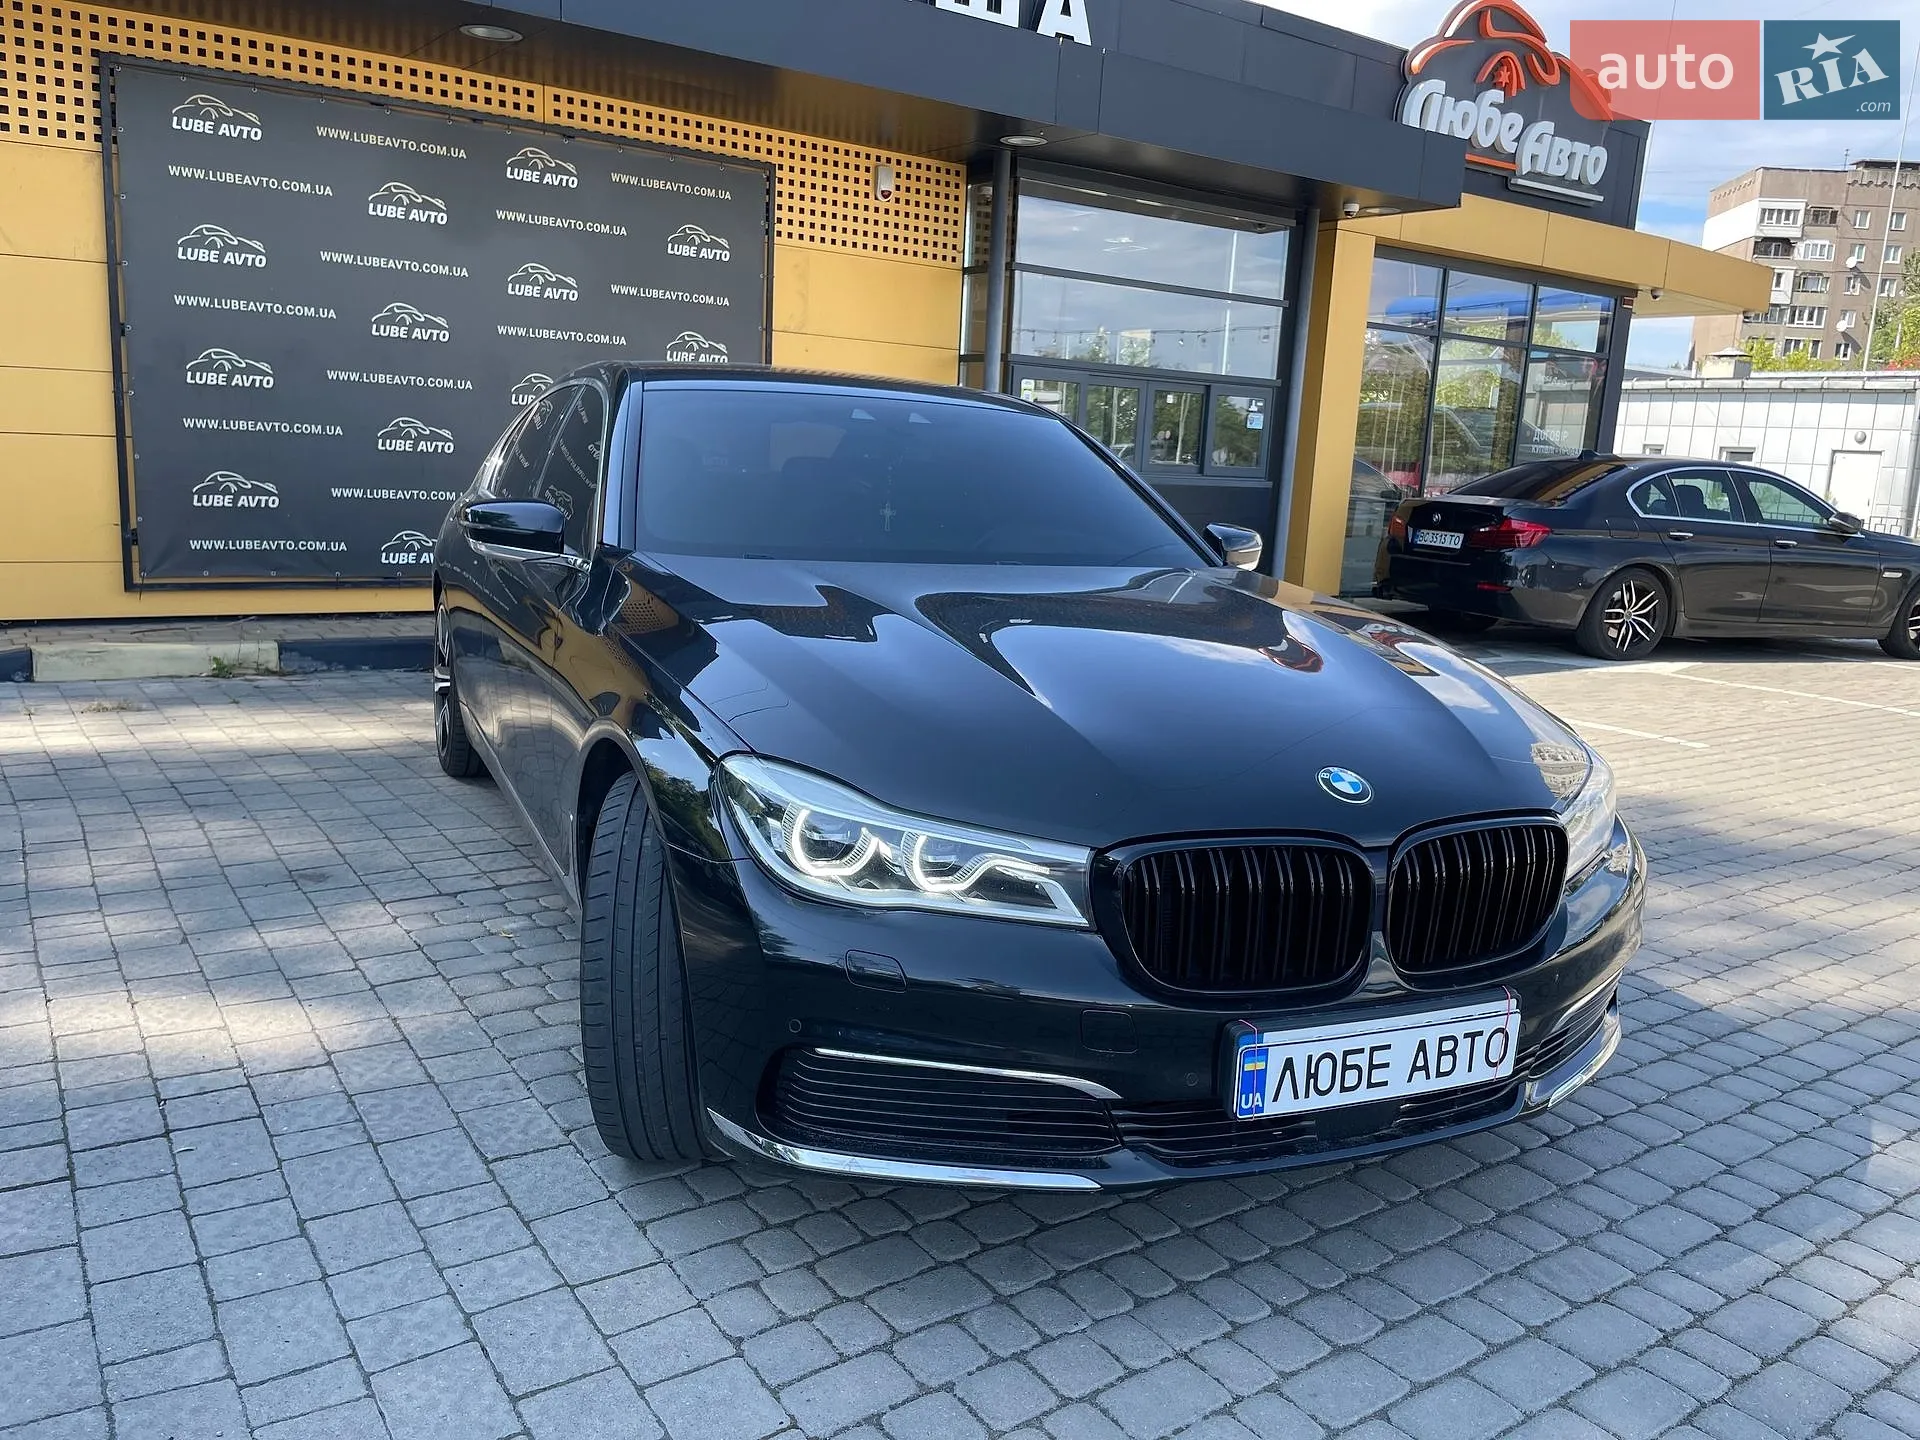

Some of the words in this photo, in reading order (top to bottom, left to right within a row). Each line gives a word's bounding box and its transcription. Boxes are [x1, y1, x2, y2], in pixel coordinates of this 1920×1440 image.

[173, 117, 214, 135] LUBE
[218, 123, 262, 141] AVTO
[317, 126, 466, 158] WWW.LUBEAVTO.COM.UA
[1516, 121, 1608, 185] Авто
[169, 165, 332, 196] WWW.LUBEAVTO.COM.UA
[507, 167, 540, 182] LUBE
[543, 173, 577, 188] AVTO
[611, 173, 731, 200] WWW.LUBEAVTO.COM.UA
[369, 203, 406, 219] LUBE
[409, 209, 447, 224] AVTO
[496, 210, 627, 236] WWW.LUBEAVTO.COM.UA
[178, 247, 219, 262] LUBE
[223, 252, 266, 267] AVTO
[668, 243, 698, 257] LUBE
[700, 248, 730, 261] AVTO
[320, 251, 468, 277] WWW.LUBEAVTO.COM.UA
[508, 283, 541, 297] LUBE
[544, 288, 578, 301] AVTO
[611, 284, 729, 306] WWW.LUBEAVTO.COM.UA
[174, 295, 336, 318] WWW.LUBEAVTO.COM.UA
[372, 324, 408, 338] LUBE
[412, 328, 449, 341] AVTO
[498, 326, 626, 345] WWW.LUBEAVTO.COM.UA
[187, 372, 227, 385] LUBE
[232, 375, 273, 388] AVTO
[327, 370, 472, 389] WWW.LUBEAVTO.COM.UA
[183, 418, 342, 435] WWW.LUBEAVTO.COM.UA
[378, 439, 413, 451] LUBE
[417, 441, 454, 453] AVTO
[193, 495, 233, 506] LUBE
[238, 496, 279, 507] AVTO
[190, 540, 347, 551] WWW.LUBEAVTO.COM.UA
[382, 553, 416, 564] LUBE
[1272, 1044, 1391, 1102] ЛЮБЕ
[1407, 1027, 1510, 1083] АВТО
[1241, 1093, 1262, 1109] UA
